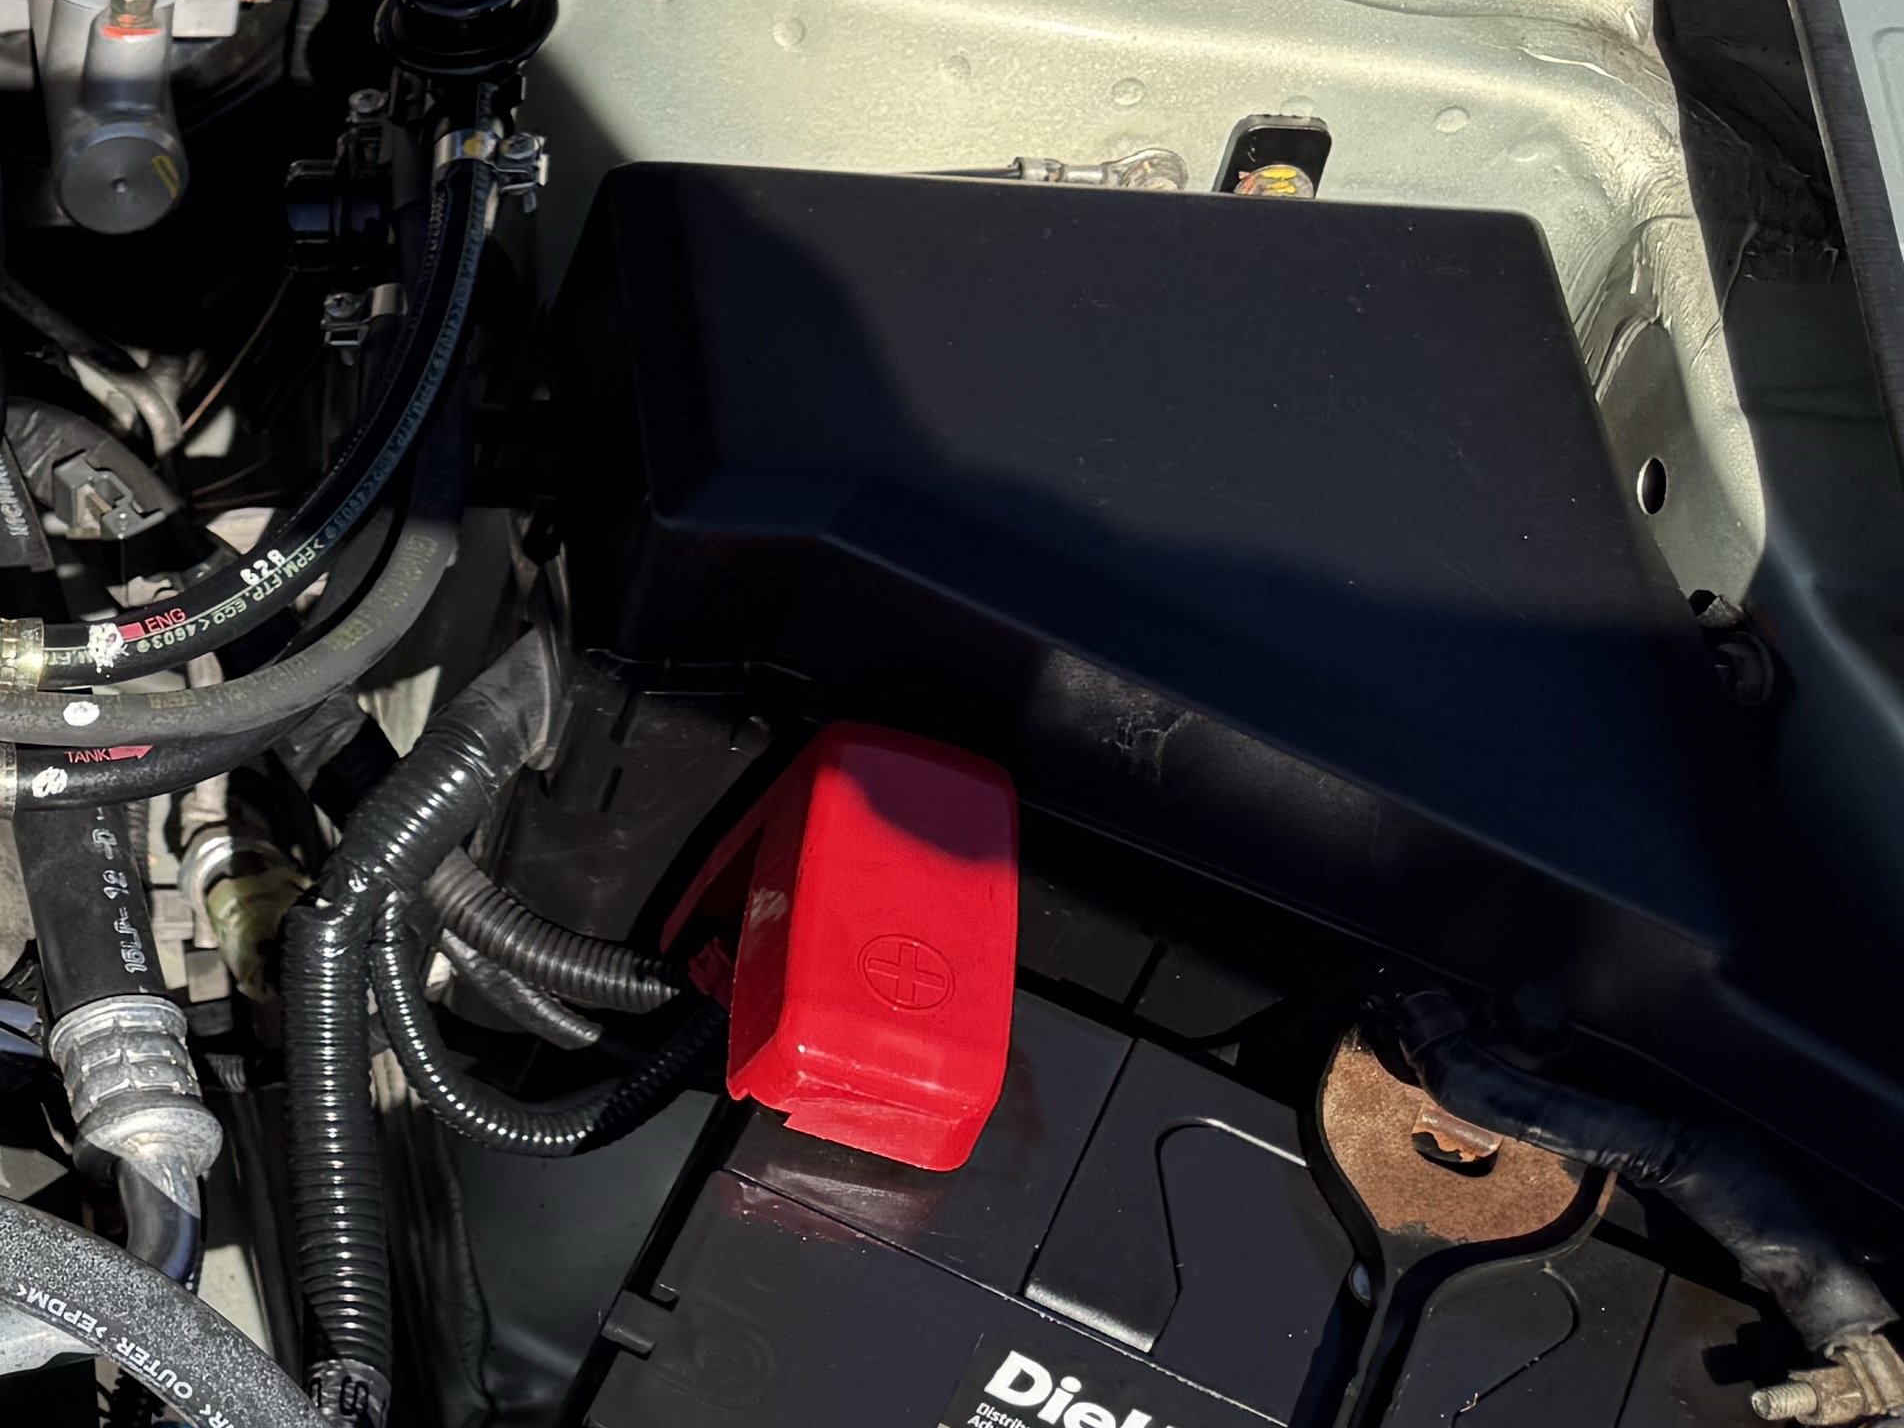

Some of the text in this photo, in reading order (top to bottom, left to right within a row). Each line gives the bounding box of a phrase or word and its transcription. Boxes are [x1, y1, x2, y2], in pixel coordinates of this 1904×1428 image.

[144, 607, 187, 634] ENG
[64, 748, 111, 765] TANK
[17, 1284, 108, 1339] >EPDM<
[116, 1335, 194, 1400] OUTER
